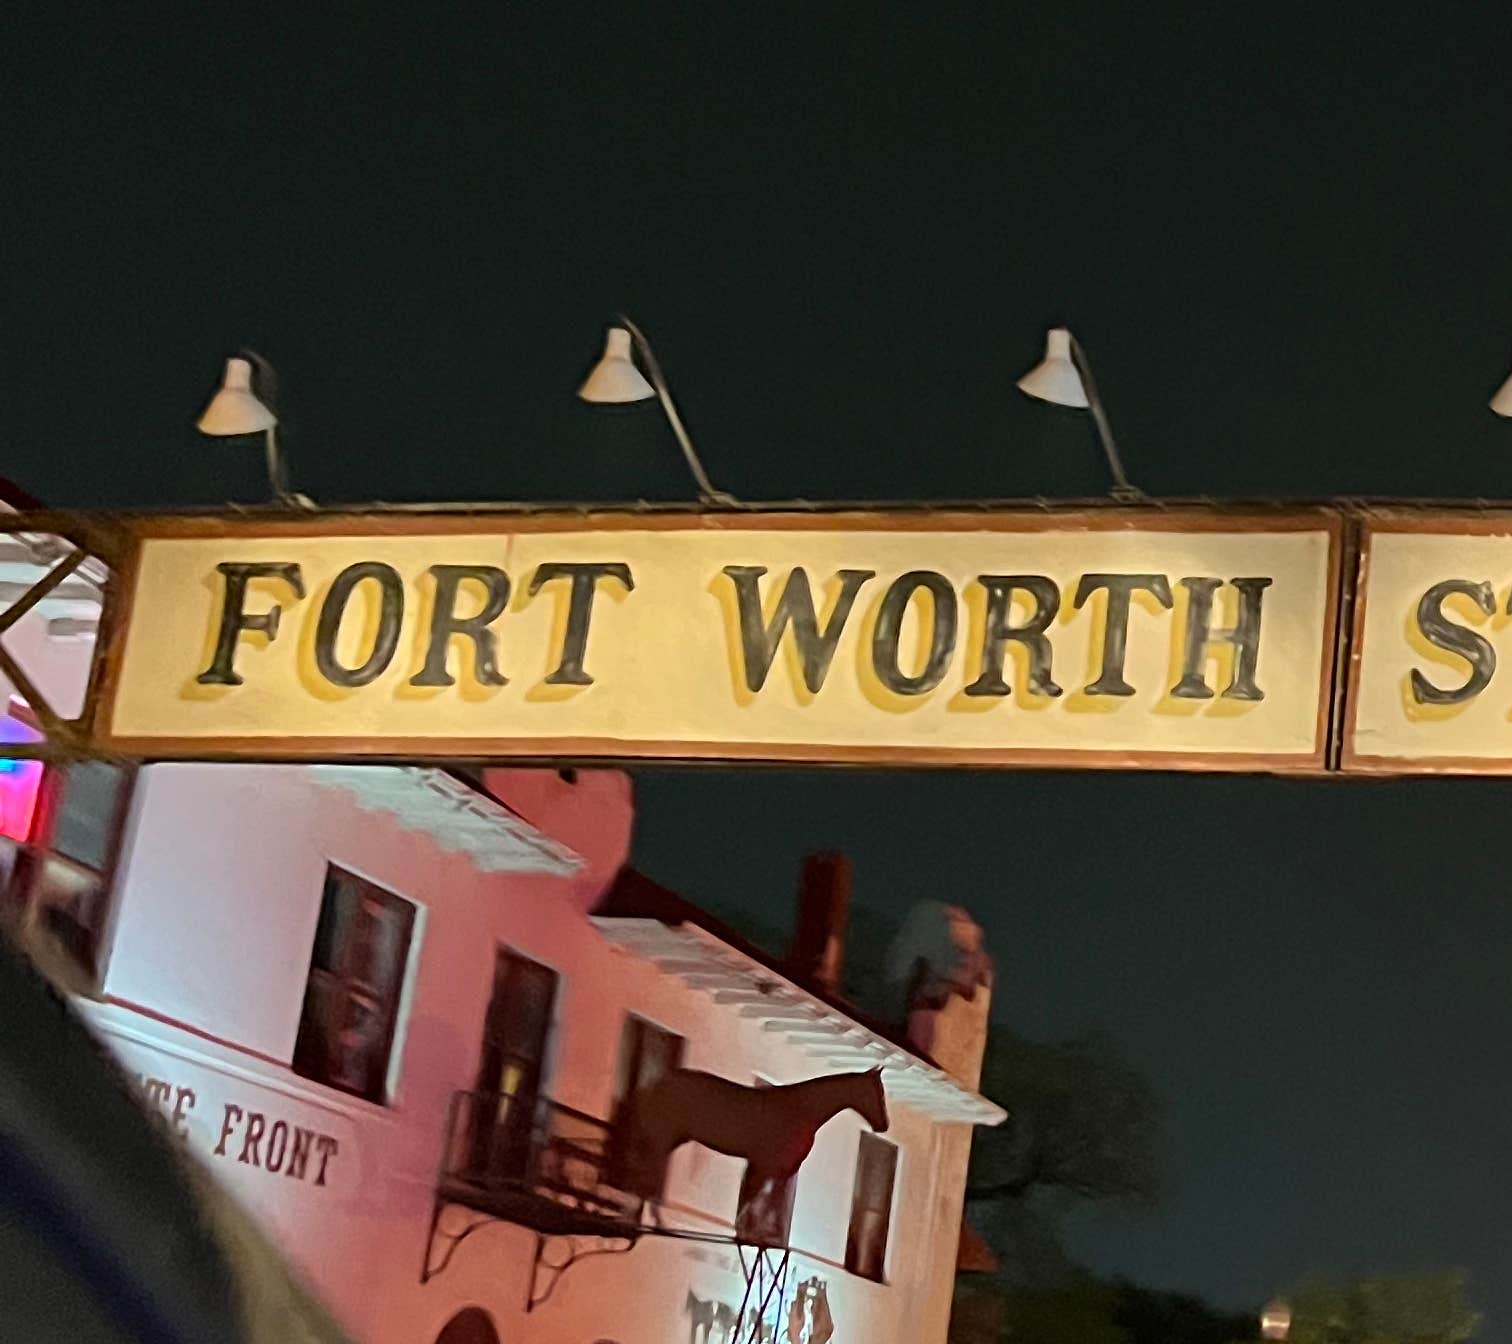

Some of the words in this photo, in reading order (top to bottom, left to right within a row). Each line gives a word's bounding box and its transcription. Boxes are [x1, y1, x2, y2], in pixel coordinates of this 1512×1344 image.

[197, 561, 635, 687] FORT
[723, 566, 1273, 701] WORTH
[213, 1102, 338, 1187] FRONT
